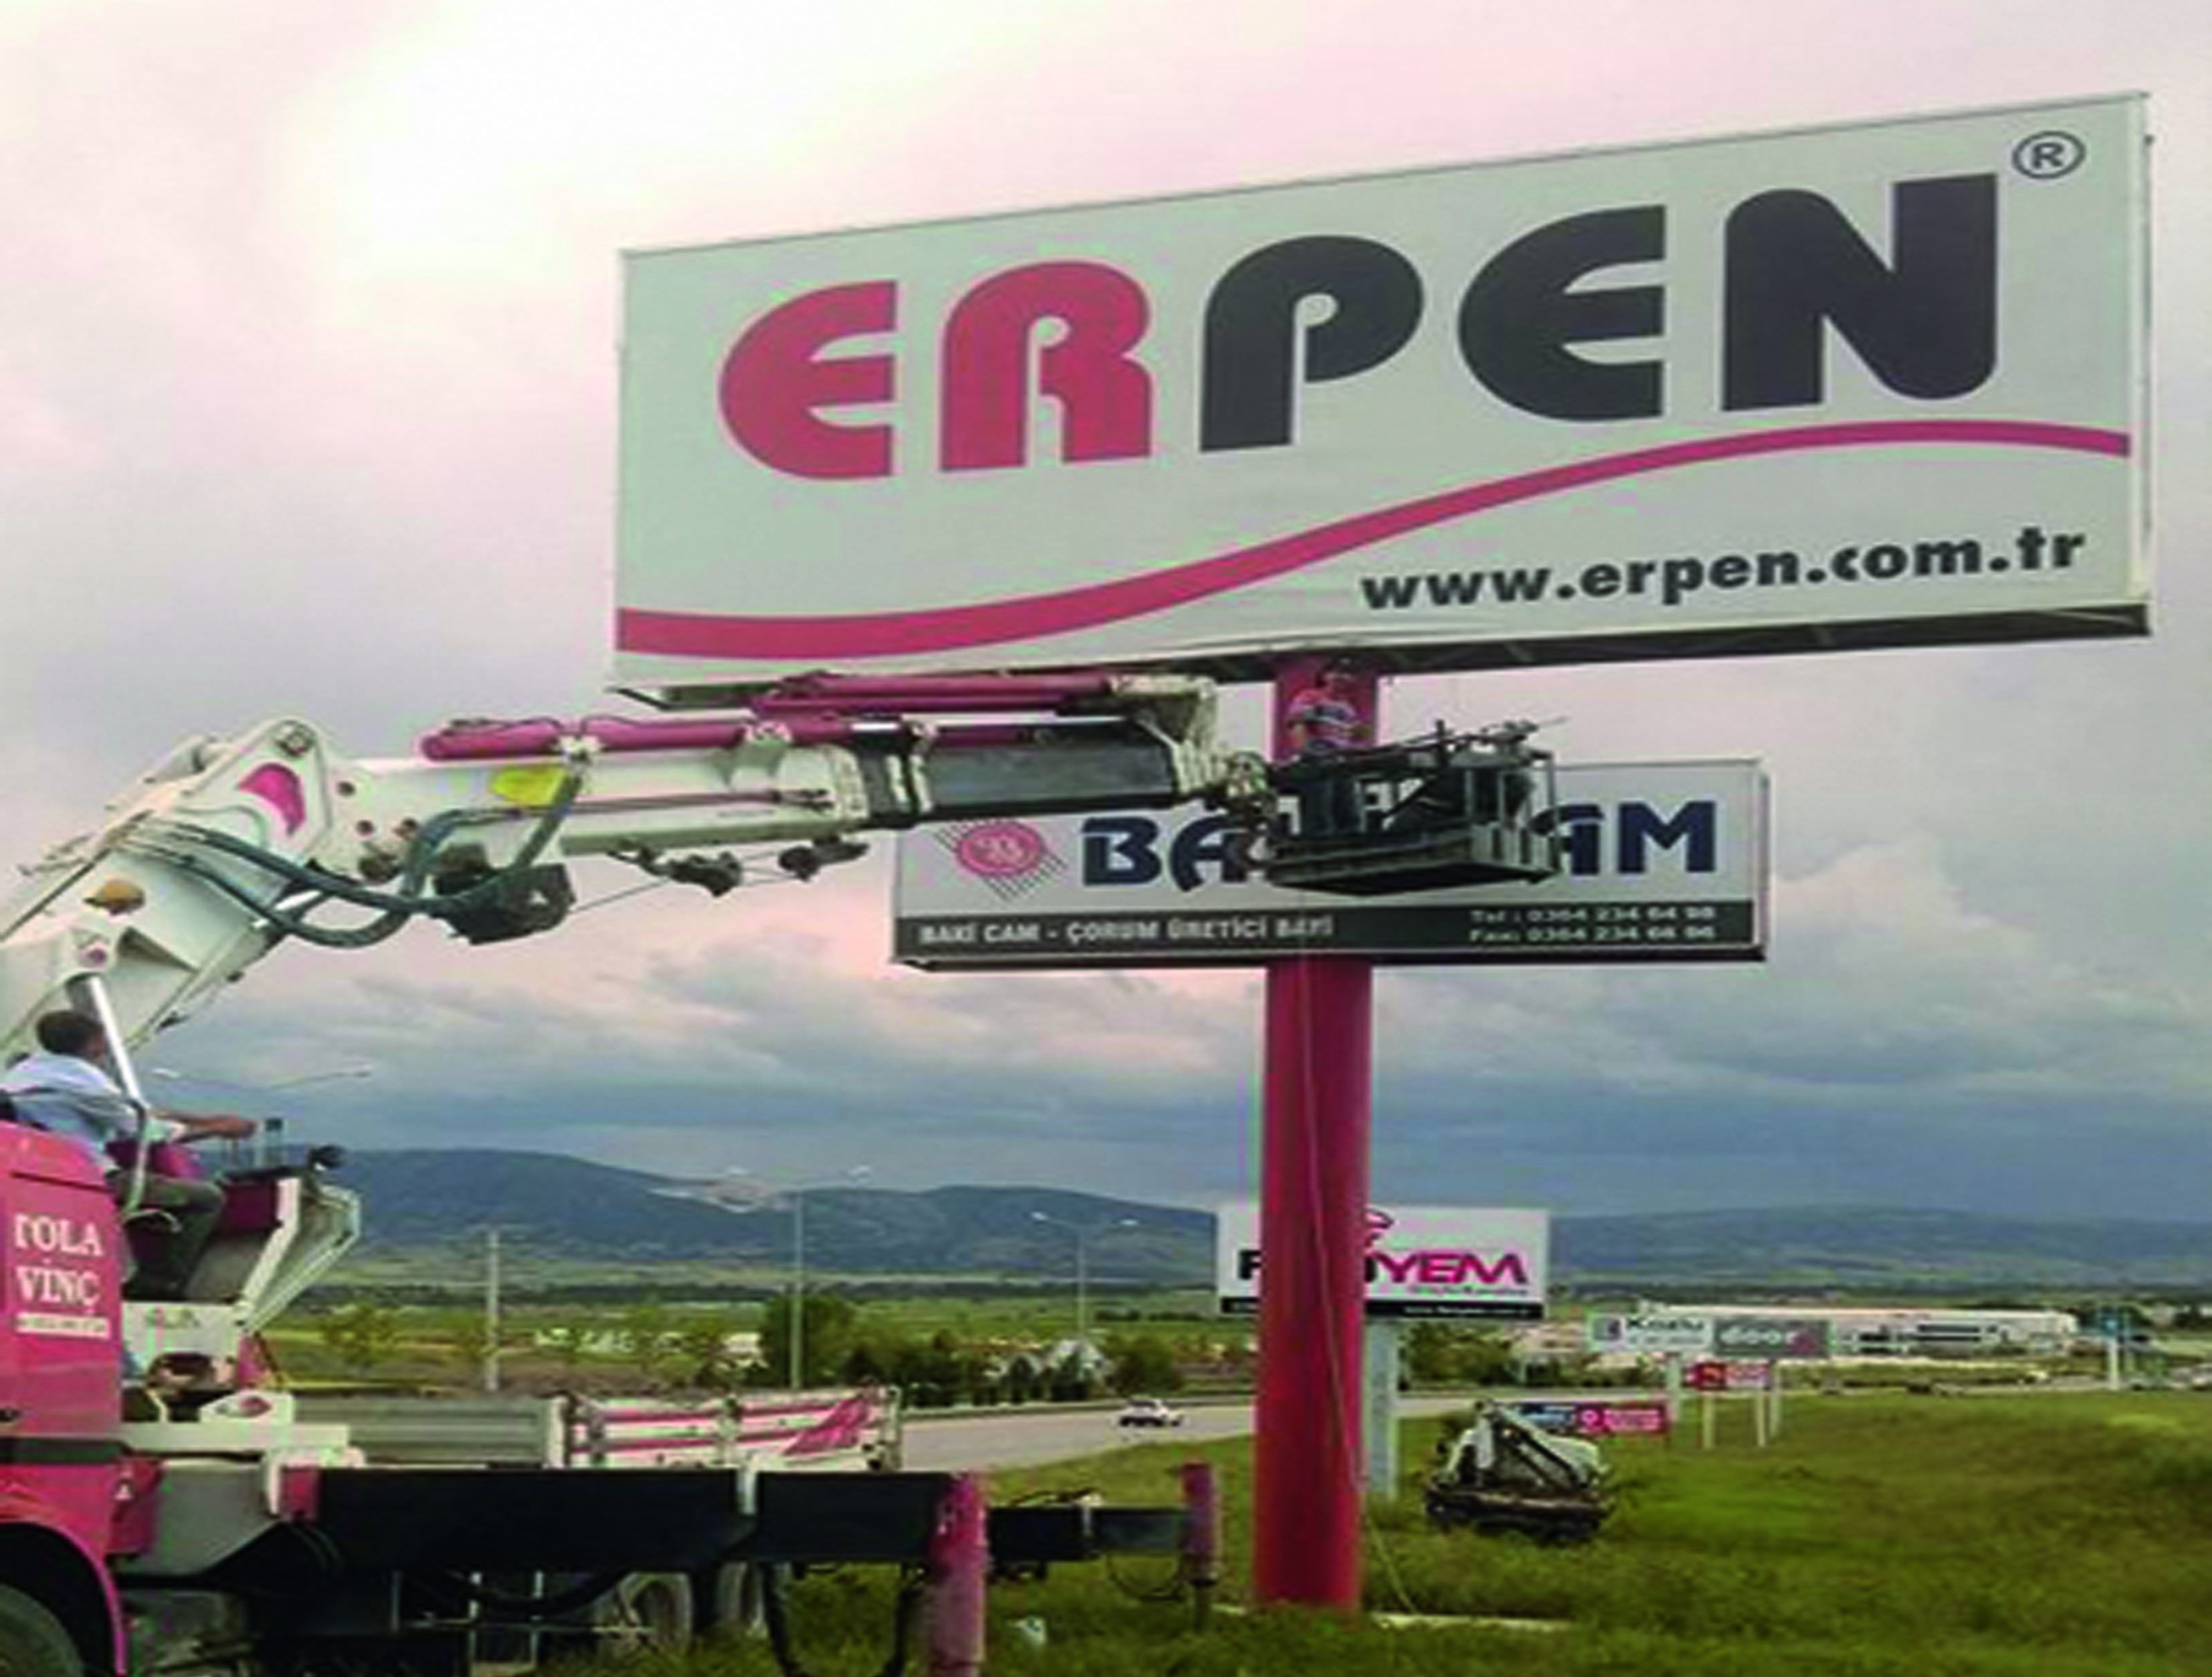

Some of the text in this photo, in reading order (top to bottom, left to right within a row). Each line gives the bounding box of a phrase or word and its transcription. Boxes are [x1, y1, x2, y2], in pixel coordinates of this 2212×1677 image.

[718, 173, 1999, 481] ERPEN
[1361, 527, 2085, 607] www.erpen.com.tr
[984, 922, 1040, 943] CAM
